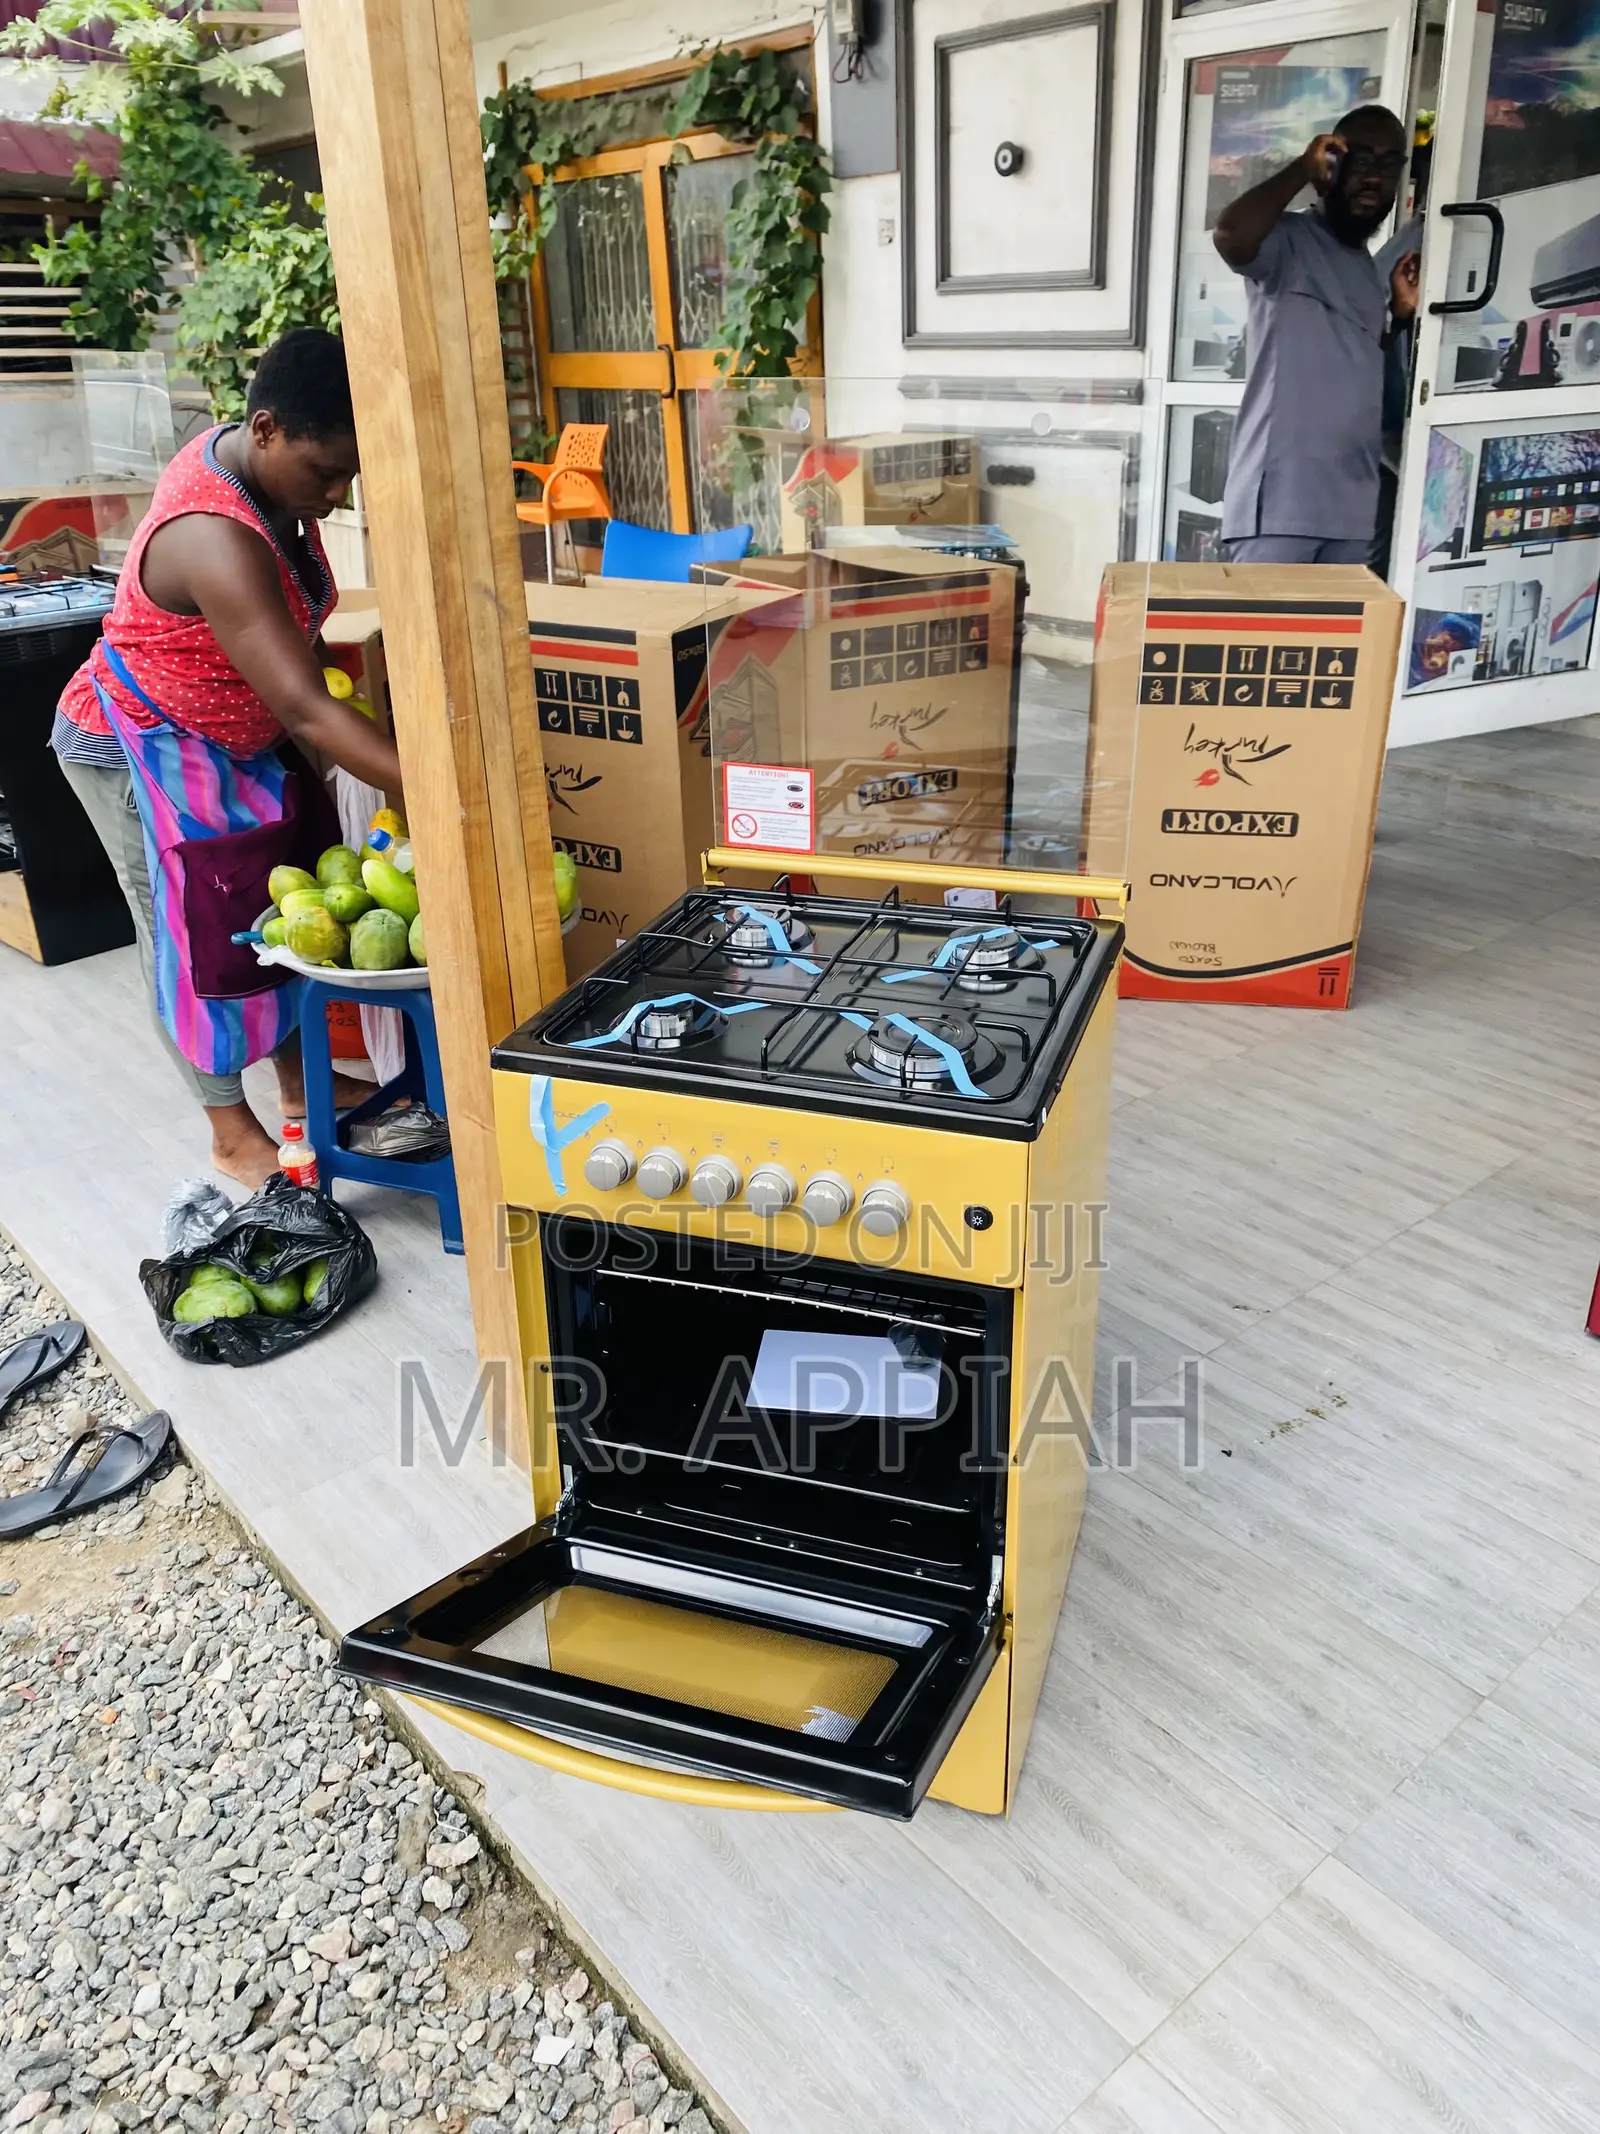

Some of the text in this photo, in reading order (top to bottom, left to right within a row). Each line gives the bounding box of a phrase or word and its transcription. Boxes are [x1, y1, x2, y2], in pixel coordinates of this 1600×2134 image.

[1184, 722, 1292, 768] Turkey
[1165, 811, 1295, 836] EXPORT
[1149, 873, 1274, 891] VOLCANO
